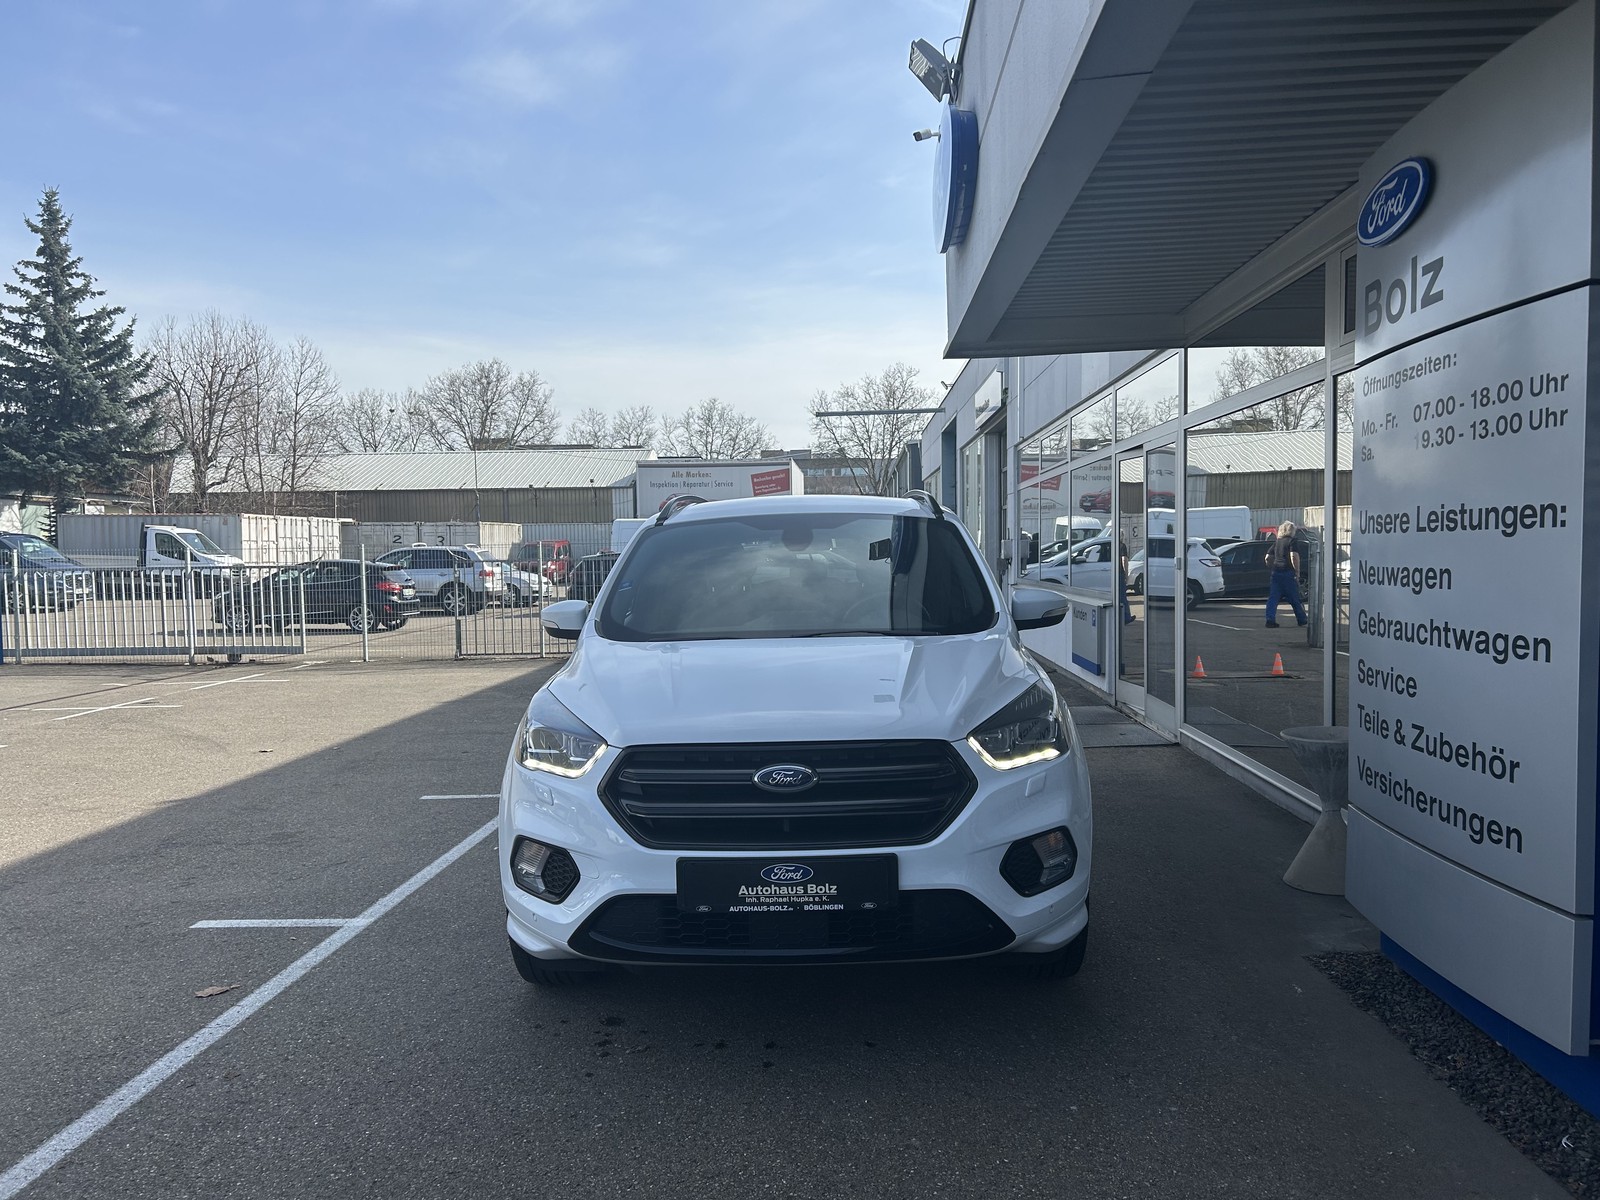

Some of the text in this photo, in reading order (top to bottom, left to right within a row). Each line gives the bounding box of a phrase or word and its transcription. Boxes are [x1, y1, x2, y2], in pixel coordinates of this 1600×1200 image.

[1367, 177, 1407, 234] Ford
[1364, 255, 1444, 336] Bolz
[1362, 352, 1458, 397] Öffnungszeiten:
[1361, 419, 1378, 438] Mo.
[1386, 412, 1399, 431] Fr.
[1412, 396, 1456, 424] 07.00
[1471, 379, 1524, 410] 18.00
[1529, 373, 1570, 398] Uhr
[1360, 445, 1375, 464] Sa.
[1470, 411, 1523, 440] 13.00
[1528, 406, 1569, 431] Uhr
[649, 479, 734, 489] Inspektion Reparatur Service
[685, 470, 712, 478] Marken:
[1359, 502, 1568, 538] Unsere Leistungen:
[392, 534, 403, 544] 2
[435, 535, 445, 547] 3
[1358, 559, 1452, 596] Neuwagen
[1358, 608, 1552, 665] Gebrauchtwagen
[1357, 658, 1419, 699] Service
[1357, 703, 1521, 784] Teile & Zubehör
[768, 770, 803, 785] Ford
[1356, 755, 1523, 855] Versicherungen
[738, 883, 838, 895] Autohaus Bolz
[770, 865, 804, 880] Ford
[760, 896, 789, 904] Raphael
[803, 903, 844, 911] BÖBLINGEN
